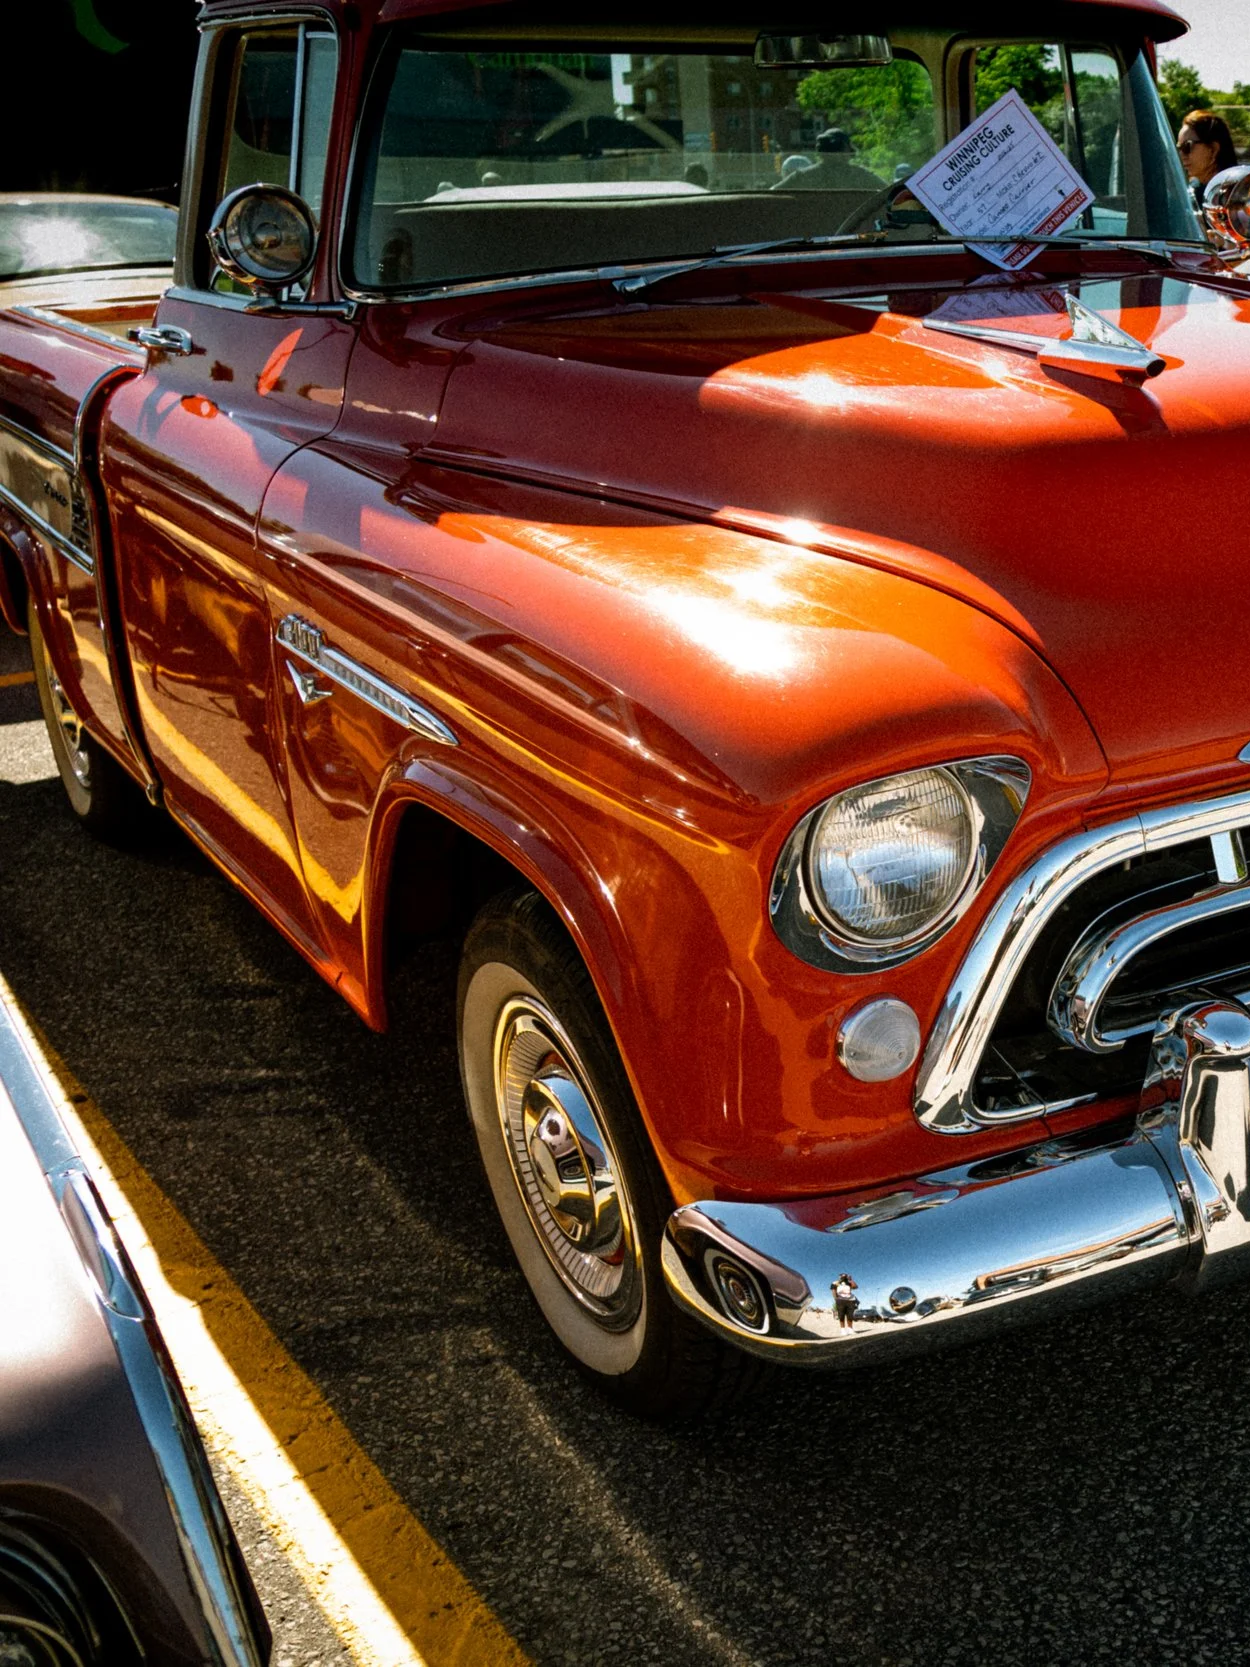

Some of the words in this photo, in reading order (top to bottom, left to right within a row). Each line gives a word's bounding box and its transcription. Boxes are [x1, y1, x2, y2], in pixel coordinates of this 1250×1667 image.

[942, 155, 981, 191] CRUISING
[979, 124, 1015, 158] CULTURE
[945, 126, 994, 171] WINNIPEG
[1063, 192, 1087, 214] VEHICLE
